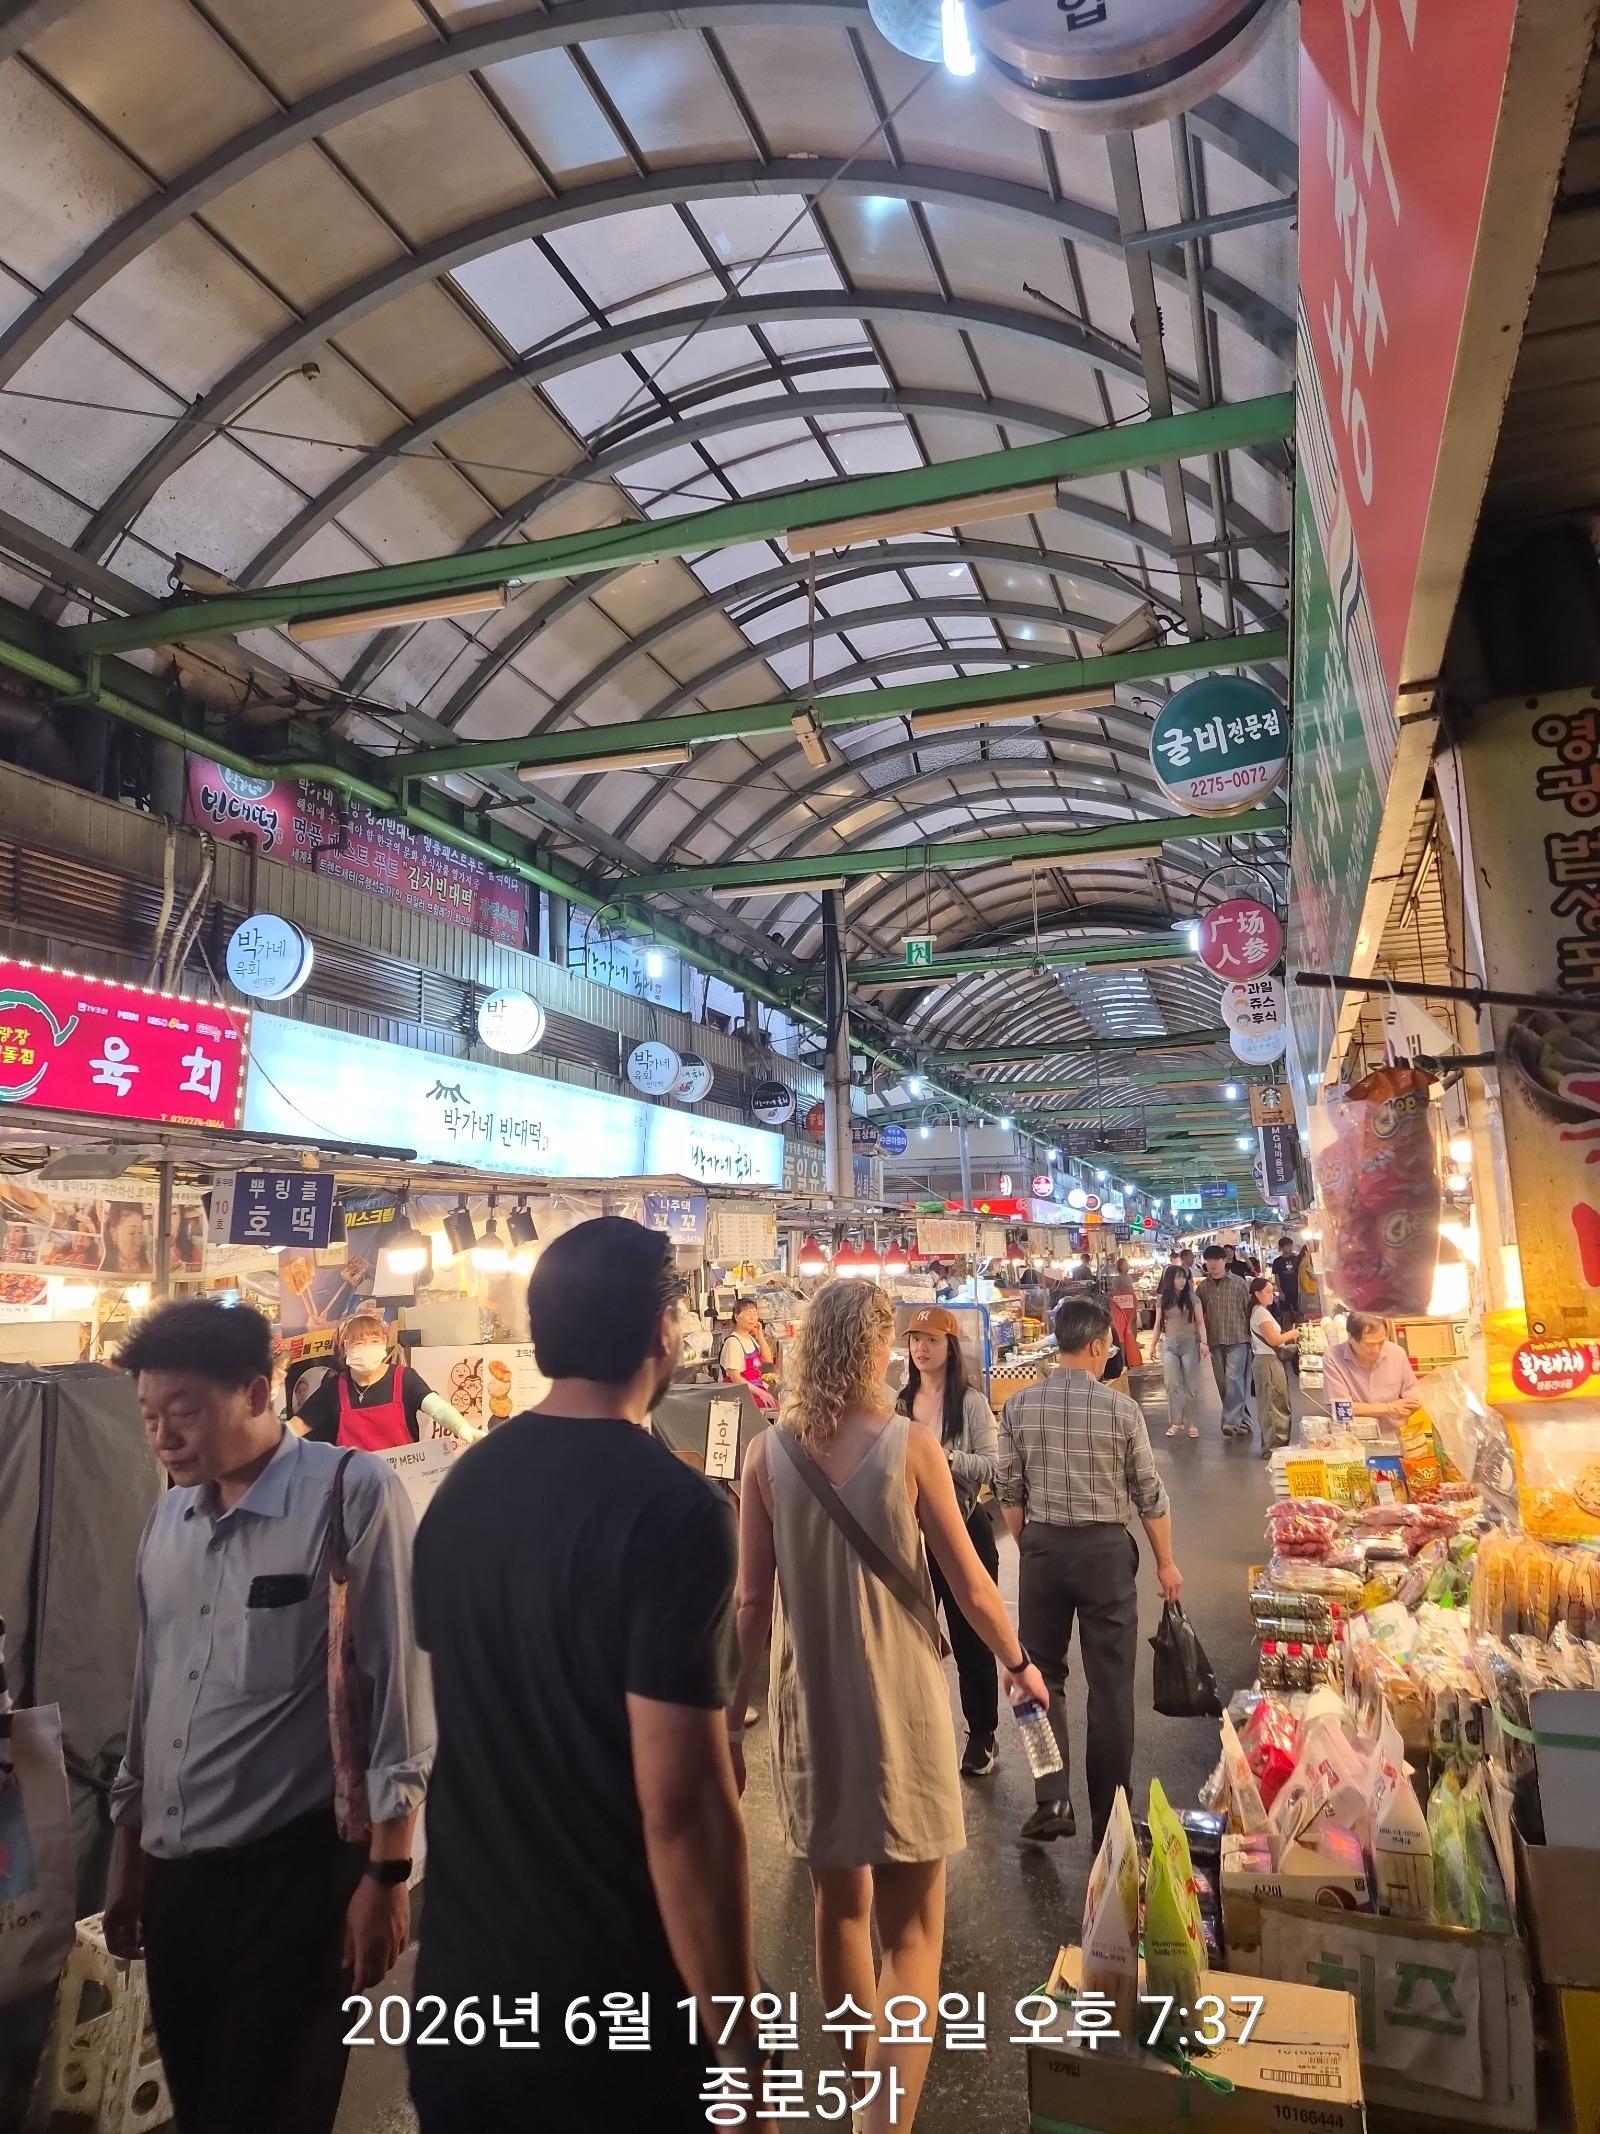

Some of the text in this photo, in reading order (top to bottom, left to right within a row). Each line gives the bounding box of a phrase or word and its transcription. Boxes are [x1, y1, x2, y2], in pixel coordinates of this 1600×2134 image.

[1157, 708, 1280, 767] 굴비 전문점
[1190, 765, 1268, 798] 2275-0072
[201, 784, 278, 852] 빈대떡
[293, 816, 323, 849] 명품
[372, 849, 400, 881] 푸드
[1210, 908, 1265, 943] 广场
[238, 927, 287, 960] 박가네
[1215, 936, 1270, 970] 人参
[233, 959, 261, 980] 육회
[1247, 980, 1273, 995] 과일
[1250, 995, 1276, 1010] 쥬스
[1252, 1010, 1278, 1025] 후식
[635, 1049, 671, 1071] 박가네
[444, 1106, 542, 1153] 박가네 빈대떡
[691, 1144, 733, 1176] 박가네
[248, 1177, 319, 1202] 뿌링클
[214, 1200, 230, 1215] 10
[660, 1199, 691, 1212] 나주댁
[215, 1218, 226, 1231] 호
[244, 1205, 317, 1241] 호떡
[400, 1451, 426, 1466] MENU
[715, 1418, 731, 1478] 호떡
[1273, 2104, 1344, 2129] 10166444
